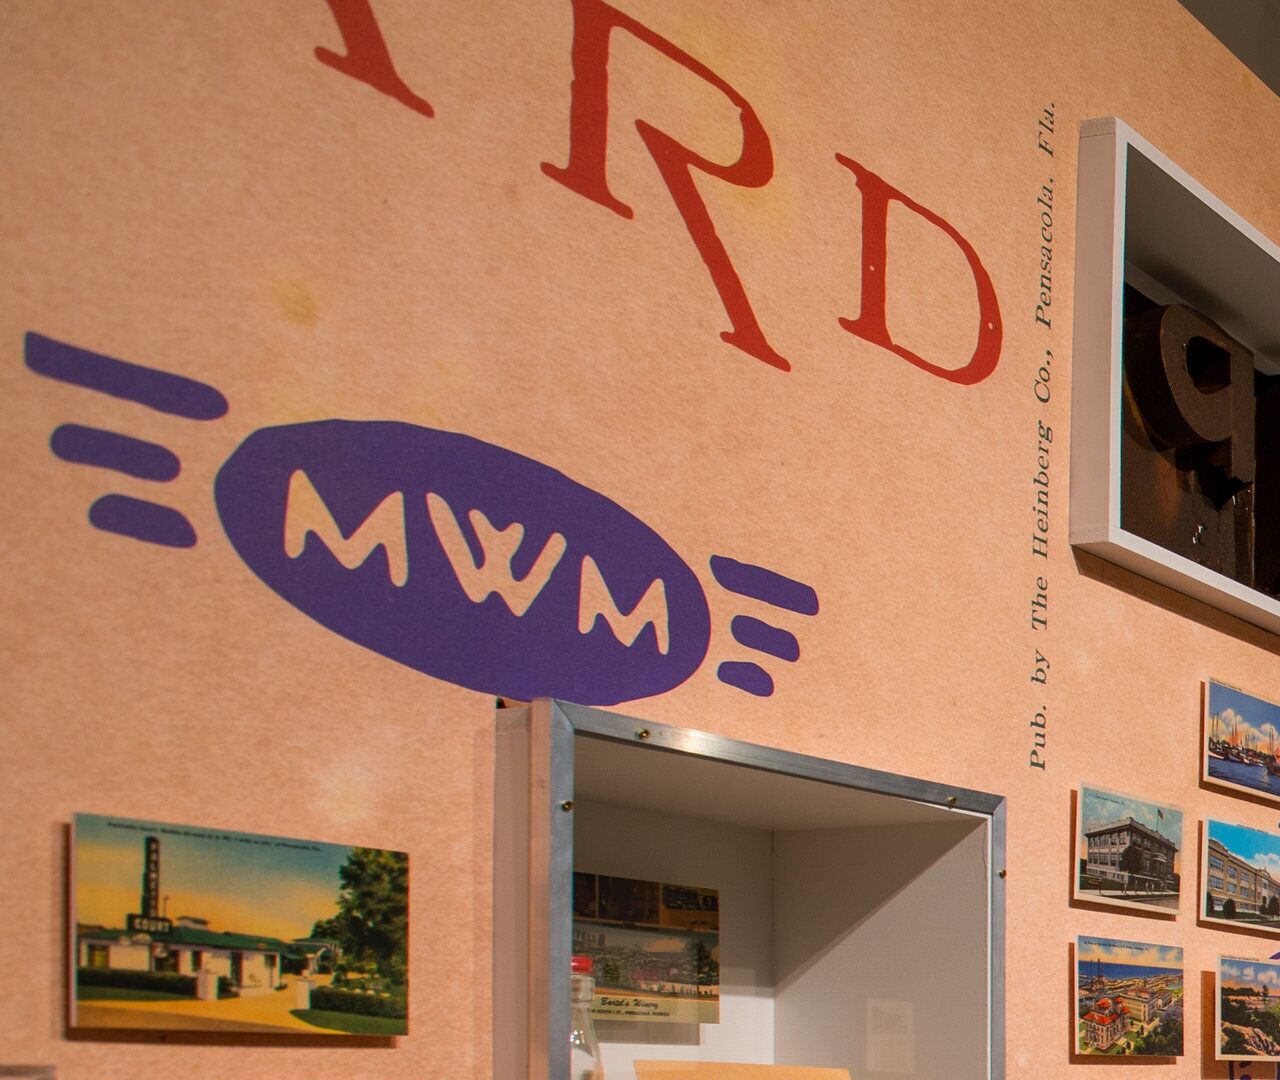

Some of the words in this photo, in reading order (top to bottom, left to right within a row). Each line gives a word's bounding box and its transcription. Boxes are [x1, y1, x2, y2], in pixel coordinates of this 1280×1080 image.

[1038, 101, 1057, 158] Fla.
[1035, 176, 1056, 330] Pensacola,
[1034, 349, 1055, 403] Co.,
[1033, 420, 1053, 561] Heinberg
[283, 468, 671, 656] MWM
[1031, 577, 1049, 631] The
[1031, 648, 1051, 686] by
[1030, 704, 1047, 770] Pub.
[133, 918, 170, 932] COURT
